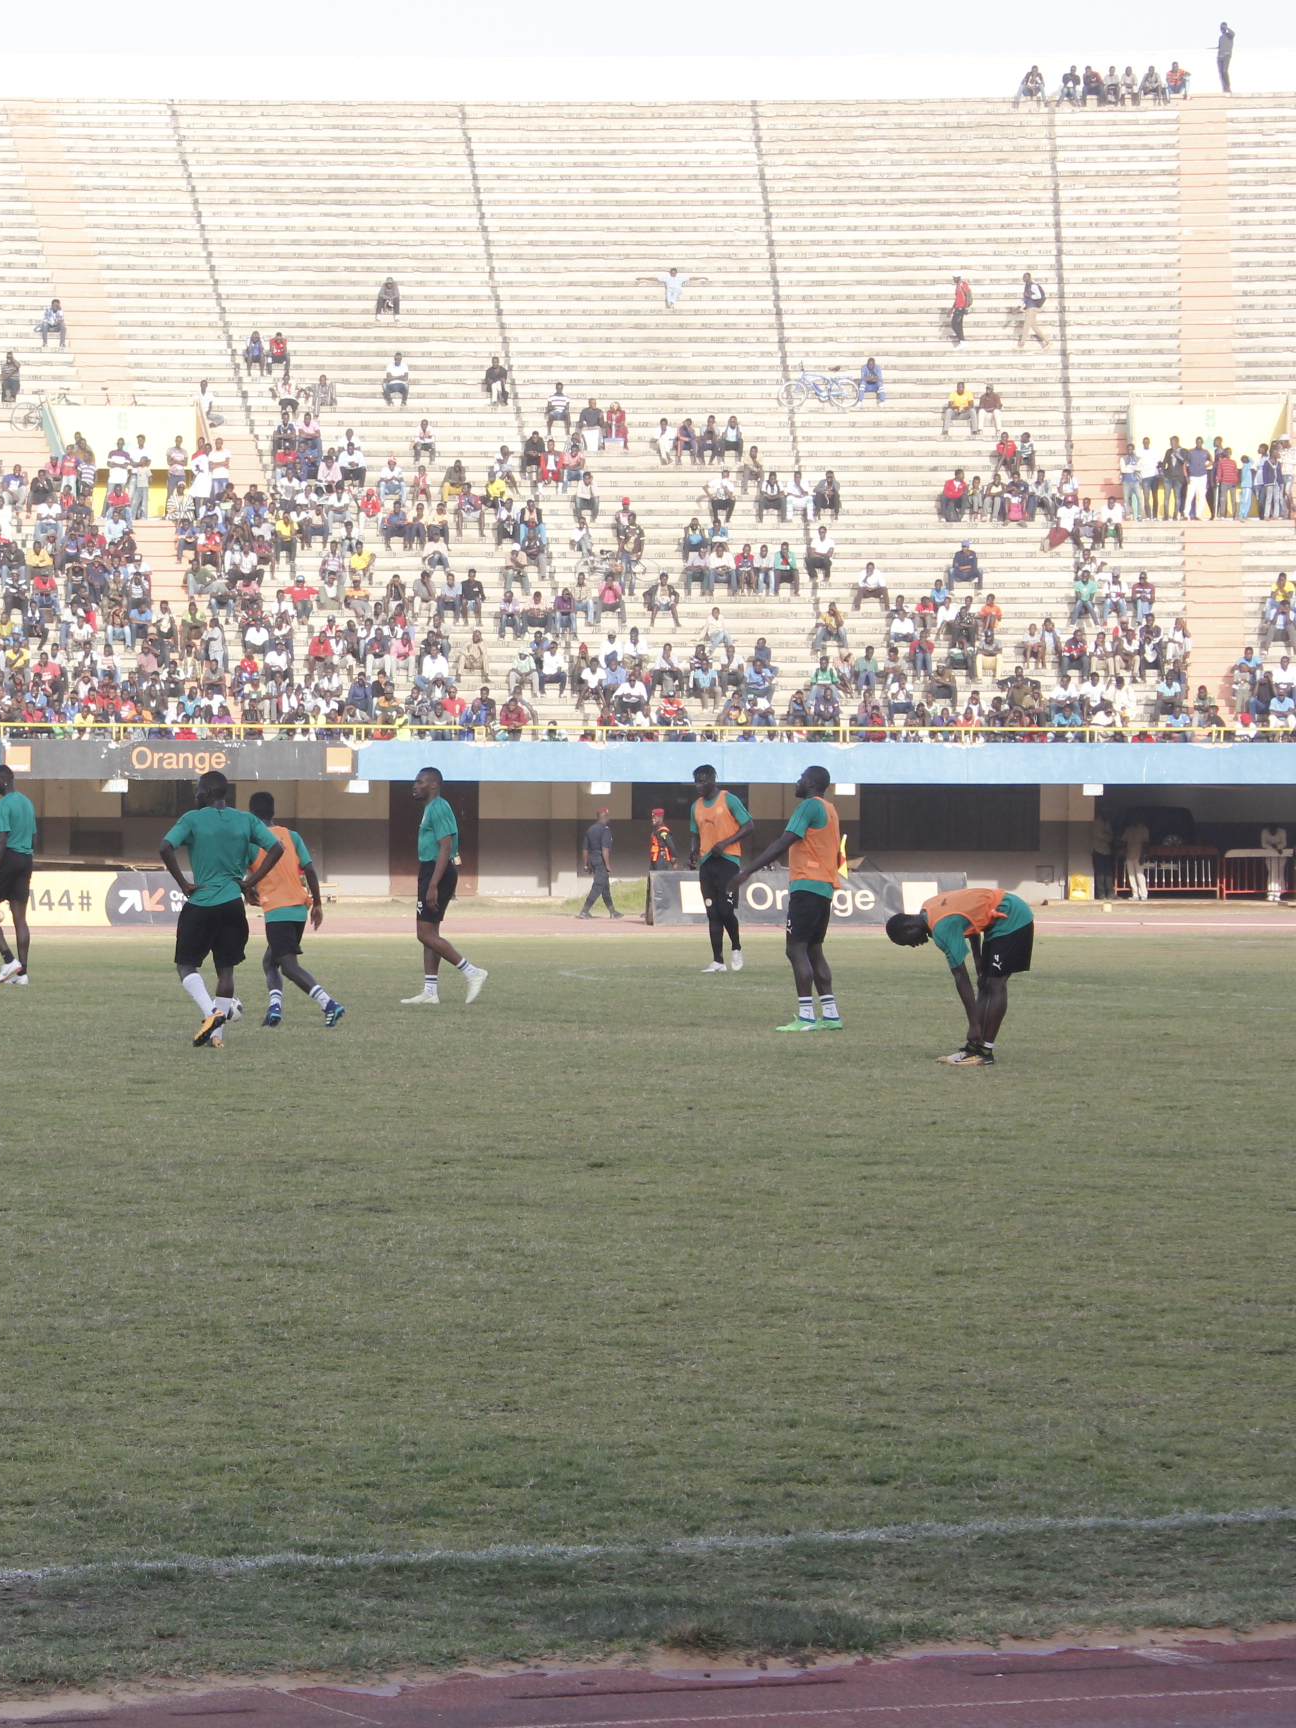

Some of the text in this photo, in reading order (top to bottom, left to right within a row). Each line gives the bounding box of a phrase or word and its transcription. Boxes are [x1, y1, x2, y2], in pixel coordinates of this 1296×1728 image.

[131, 746, 227, 775] Orange
[6, 889, 92, 912] 144#
[746, 882, 876, 917] Orge
